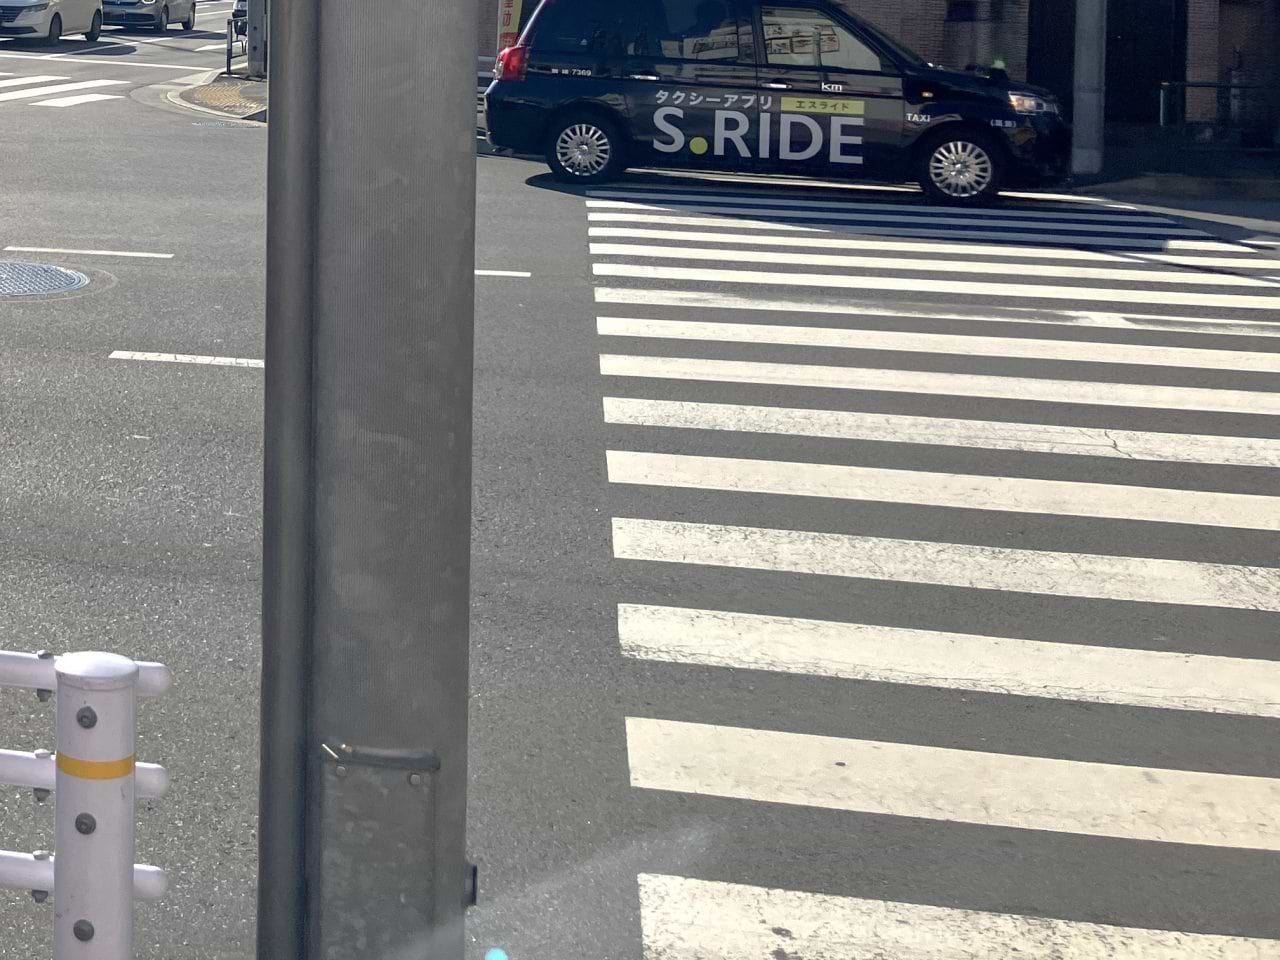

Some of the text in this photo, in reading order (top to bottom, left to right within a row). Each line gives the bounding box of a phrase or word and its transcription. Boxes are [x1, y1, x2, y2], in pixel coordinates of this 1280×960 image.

[655, 90, 772, 110] タクシーアプリ
[796, 100, 850, 111] エスライド
[906, 113, 931, 122] TAXI
